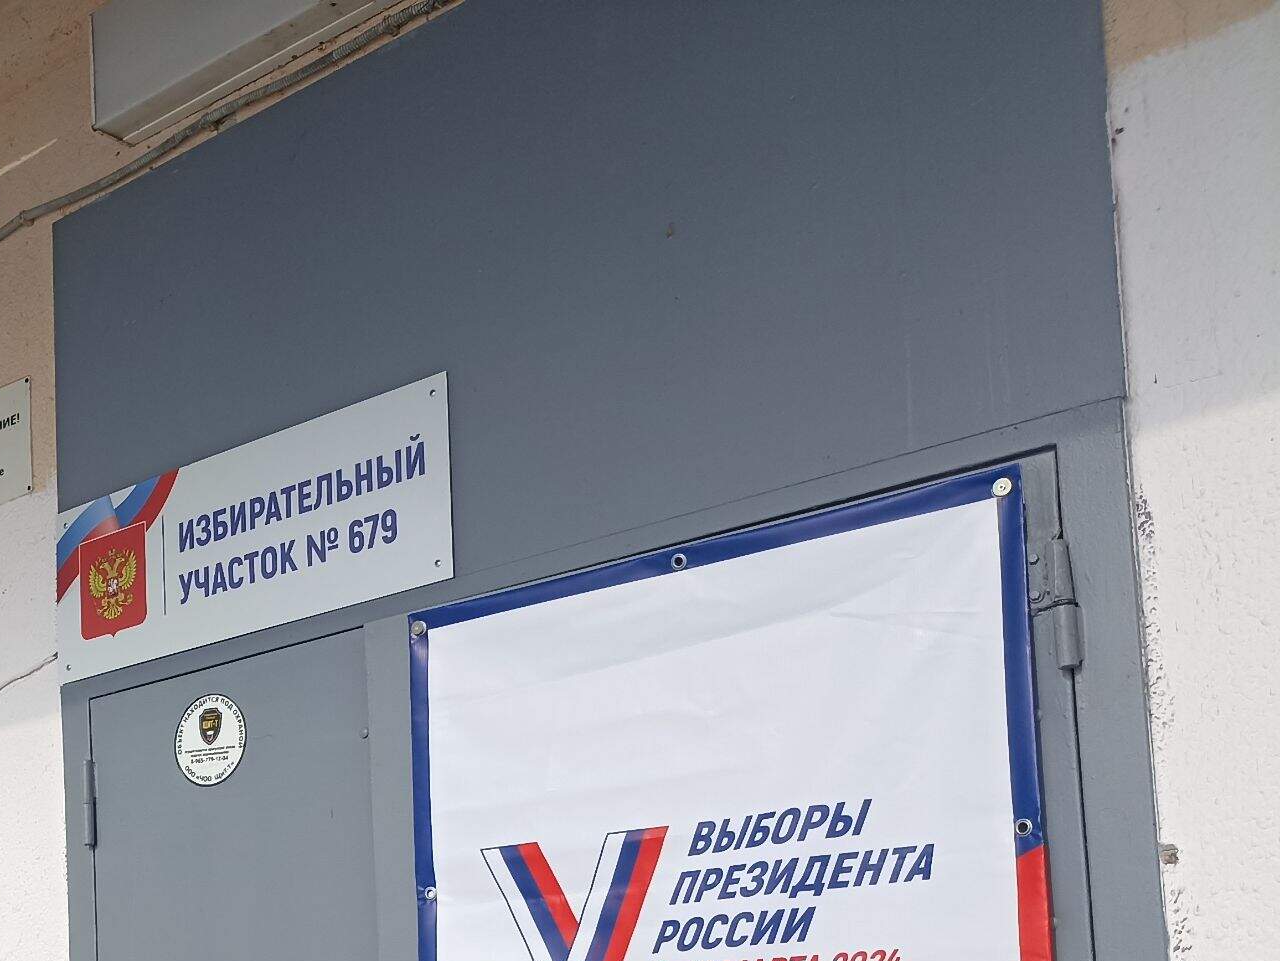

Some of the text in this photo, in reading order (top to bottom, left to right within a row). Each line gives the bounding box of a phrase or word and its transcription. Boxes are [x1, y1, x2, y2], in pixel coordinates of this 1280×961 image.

[178, 433, 426, 553] ИЗБИРАТЕЛЬНЫЙ
[179, 508, 399, 605] УЧАСТОК № 679
[183, 696, 220, 723] НАХОДИТСЯ
[220, 697, 234, 711] ПОД
[232, 709, 244, 749] ОХРАНОЙ
[687, 797, 873, 857] ВЫБОРЫ
[668, 843, 936, 906] ПРЕЗИДЕНТА
[651, 906, 817, 954] РОССИИ
